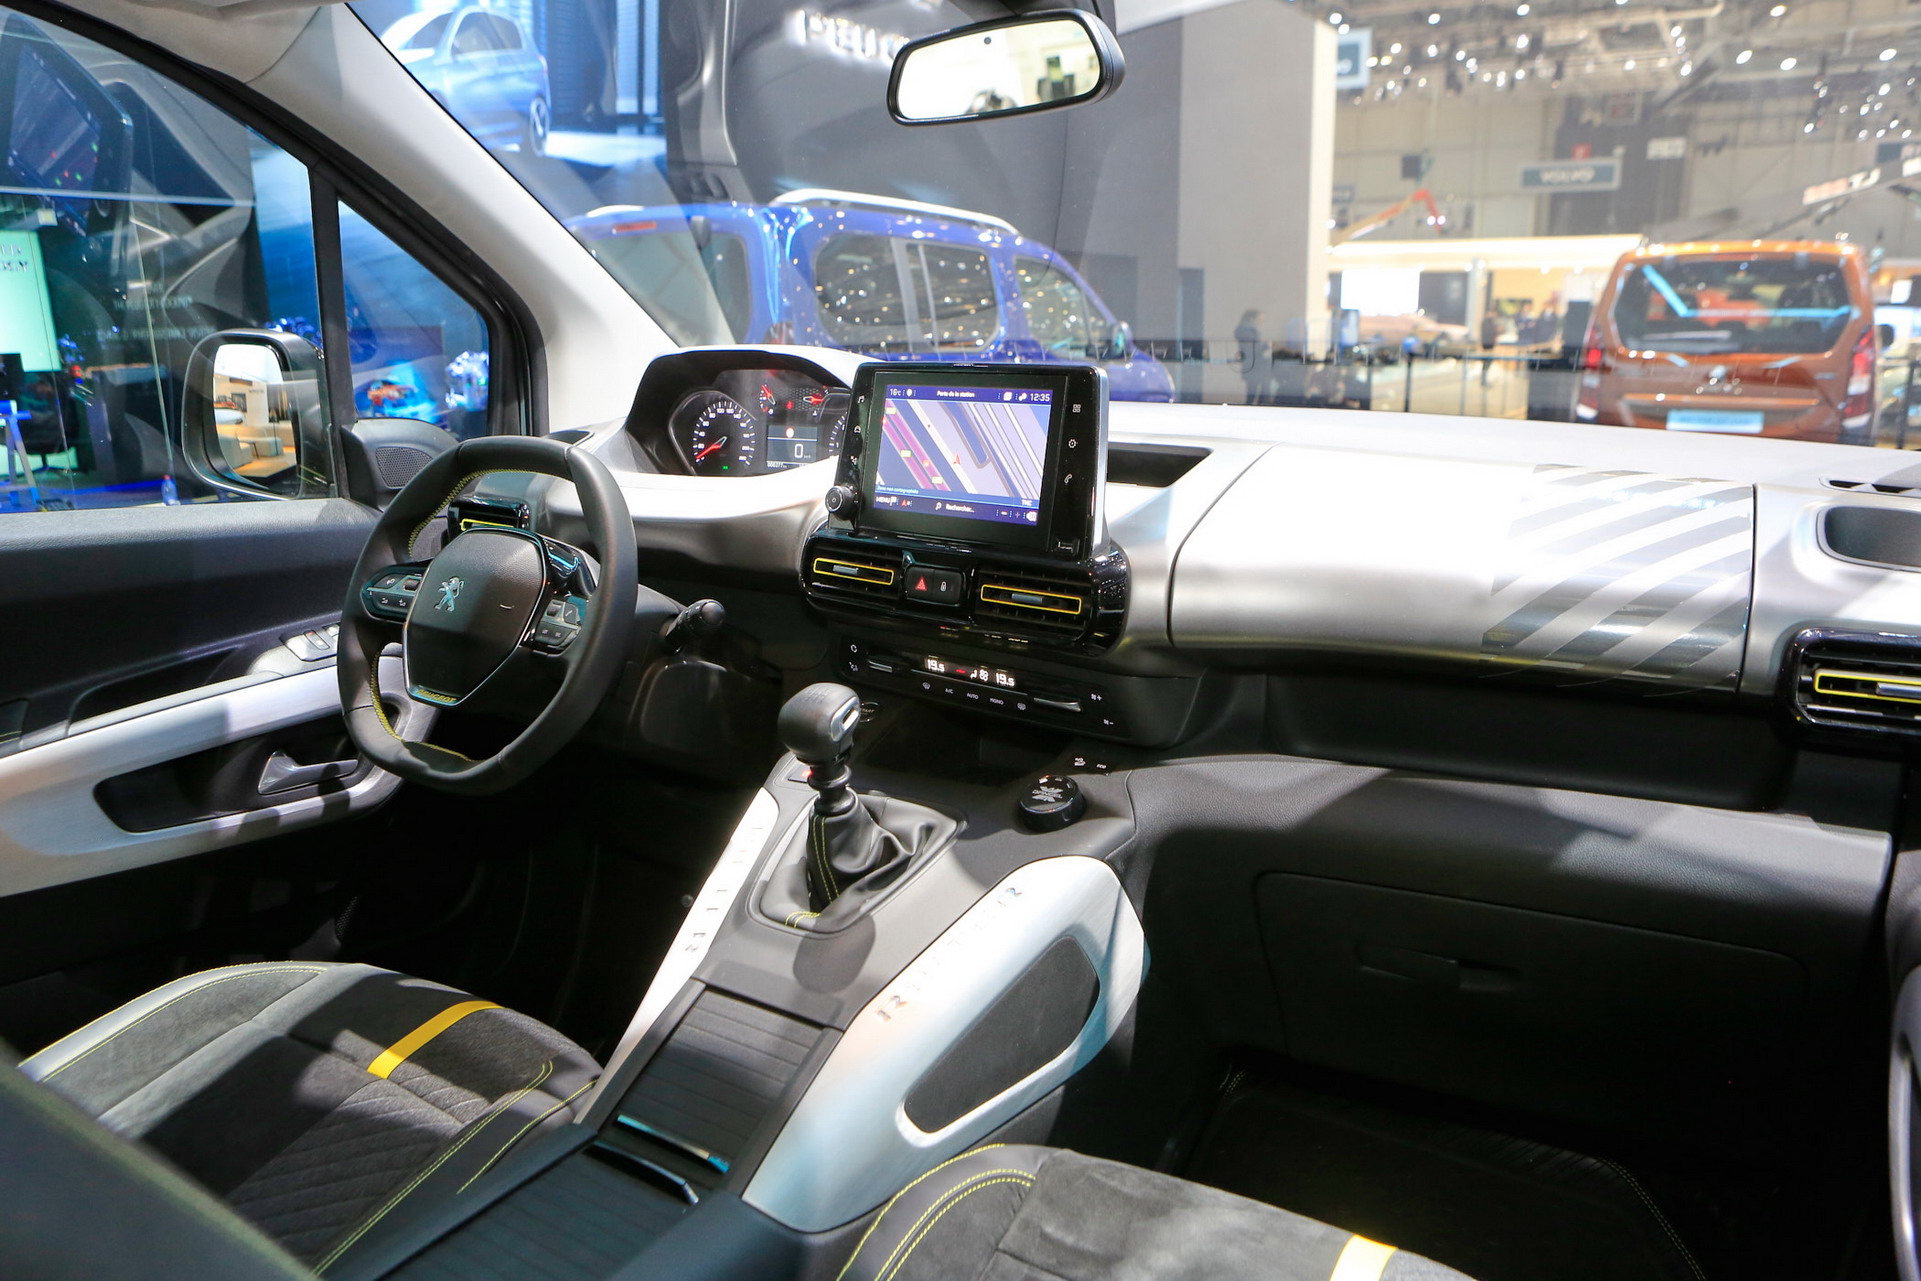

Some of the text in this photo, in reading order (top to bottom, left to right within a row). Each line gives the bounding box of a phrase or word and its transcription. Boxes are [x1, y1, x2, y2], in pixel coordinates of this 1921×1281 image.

[1030, 393, 1050, 402] 12:35
[794, 443, 804, 459] 0
[415, 689, 457, 703] PEUGEOT
